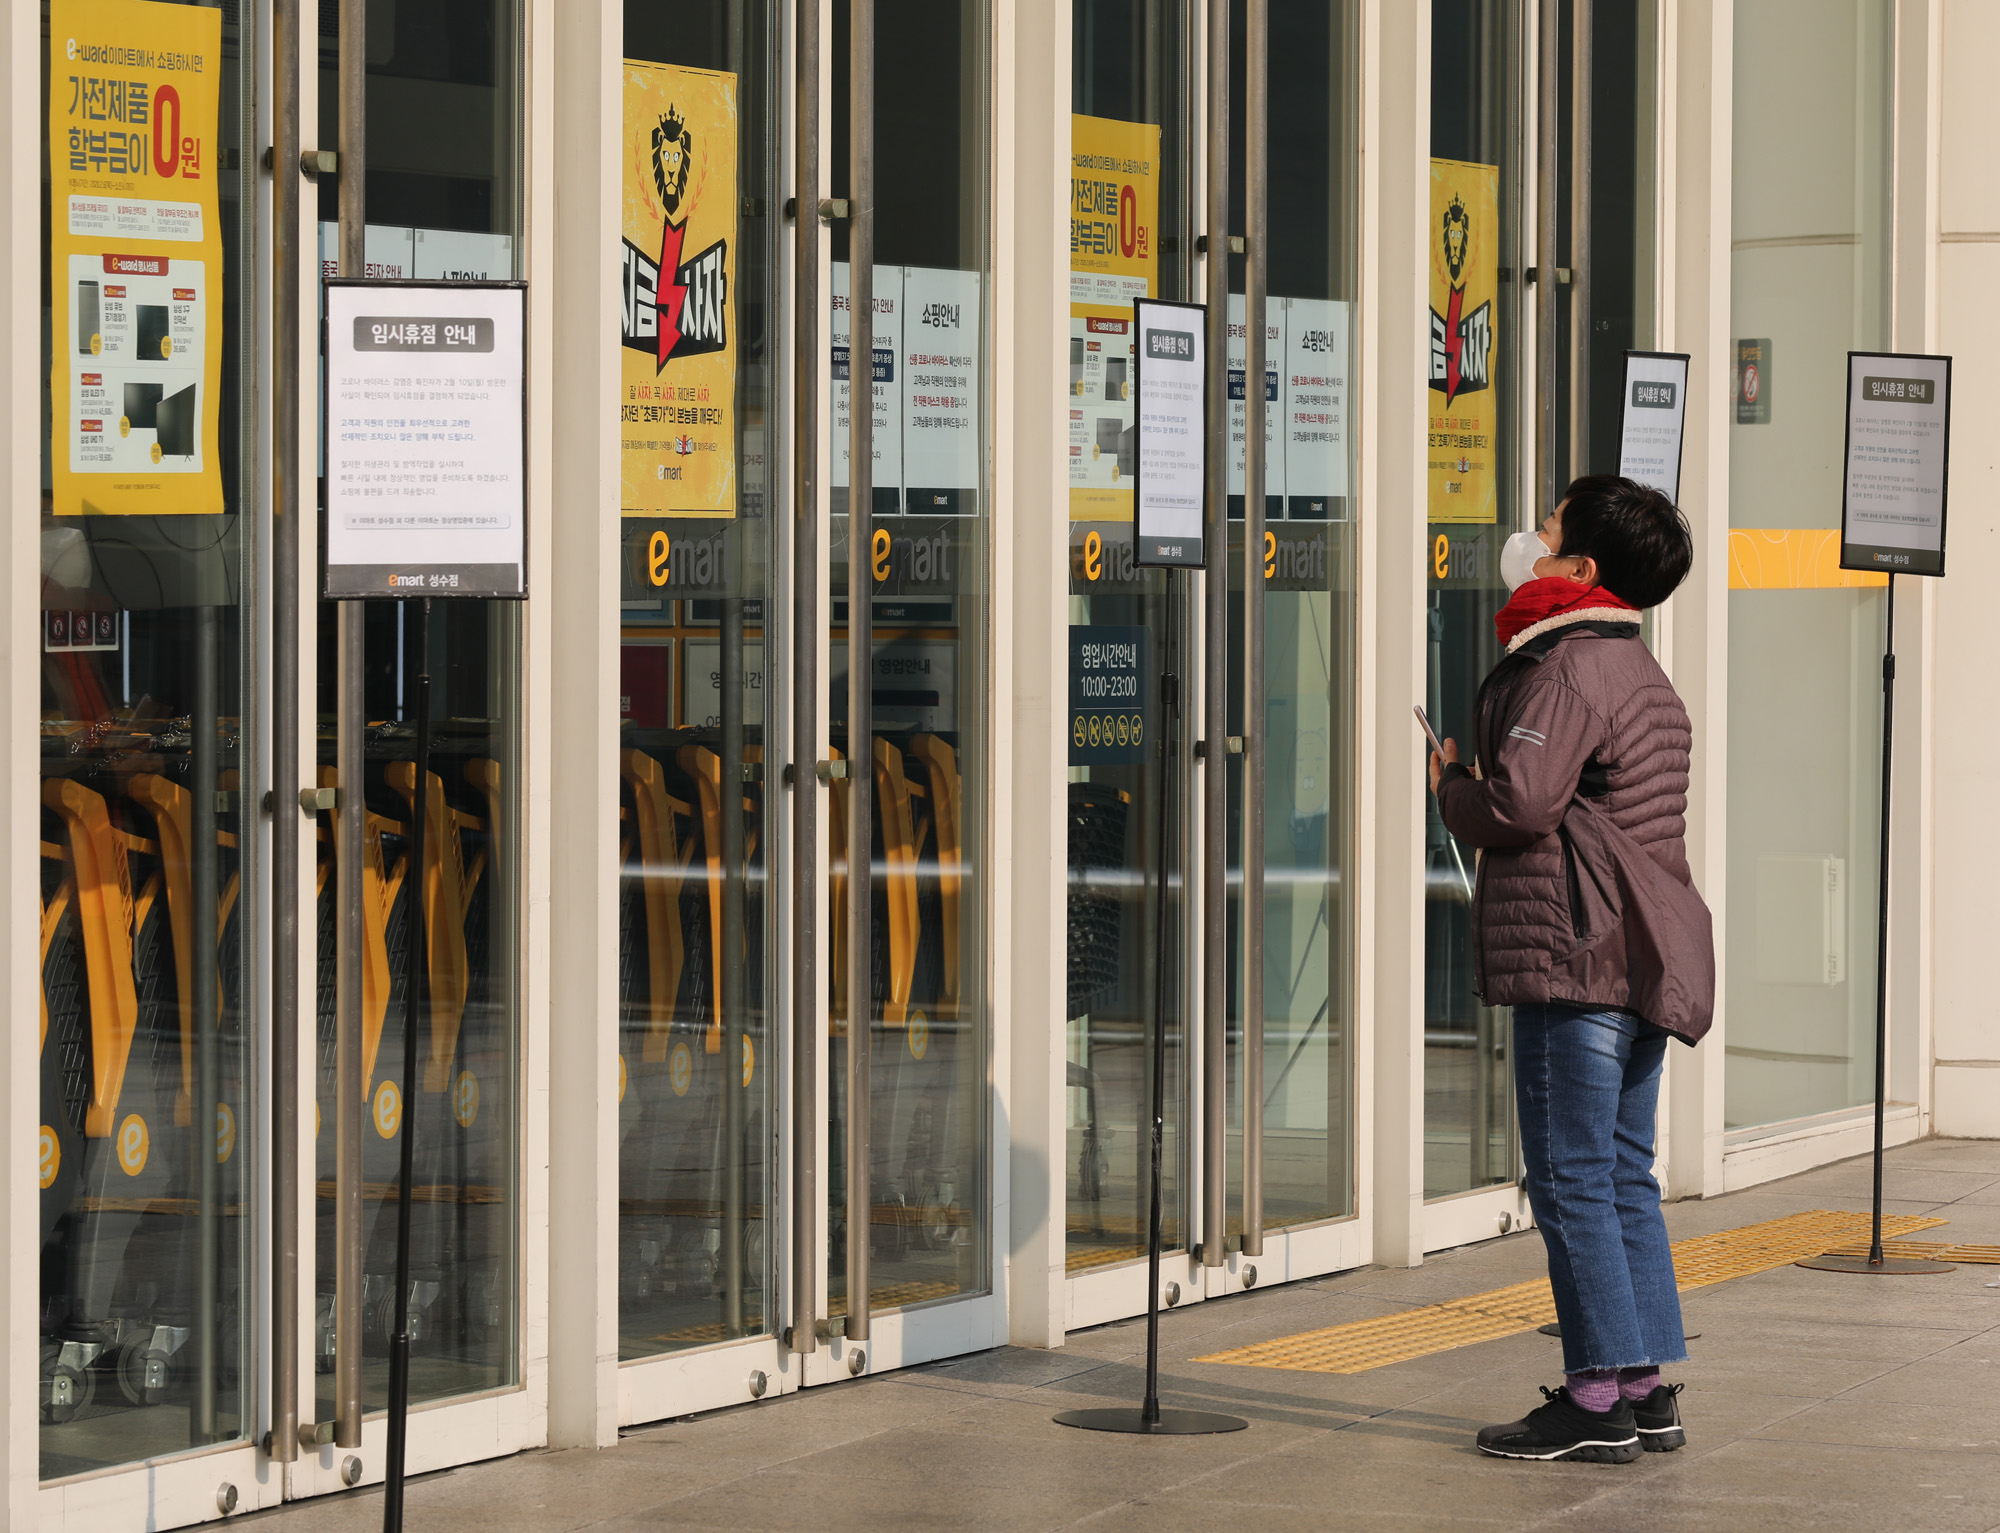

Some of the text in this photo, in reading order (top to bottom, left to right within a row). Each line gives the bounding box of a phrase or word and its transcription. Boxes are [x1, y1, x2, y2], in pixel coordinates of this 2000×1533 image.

[157, 53, 203, 72] 쇼핑하시면
[69, 76, 148, 124] 가전제품
[69, 126, 148, 175] 할부금이
[1122, 159, 1149, 176] 쇼핑하시면
[1071, 178, 1117, 216] 가전제품
[682, 246, 724, 344] 사자
[922, 303, 960, 328] 쇼핑안내
[371, 324, 476, 345] 임시휴점 안내
[1302, 330, 1334, 352] 쇼핑안내
[1152, 335, 1189, 355] 임시휴점 안내
[654, 386, 660, 400] 꼭
[678, 387, 696, 401] 제대로
[697, 388, 710, 402] 사자
[1638, 386, 1672, 403] 임시휴점 안내
[1872, 381, 1926, 398] 임시휴점 안내
[621, 405, 638, 422] 자던
[678, 407, 698, 424] 본능을
[658, 464, 682, 480] emart
[1445, 480, 1462, 494] emart
[934, 495, 947, 505] emart
[1311, 502, 1322, 512] emart
[871, 528, 950, 581] emart
[1265, 531, 1324, 579] emart
[1435, 534, 1488, 579] emart
[1873, 553, 1909, 564] emart 성수점
[388, 574, 458, 587] emart 성수점
[1082, 643, 1136, 669] 영업시간안내
[879, 658, 930, 675] 영업안내
[1081, 675, 1136, 697] 10:00-23:00
